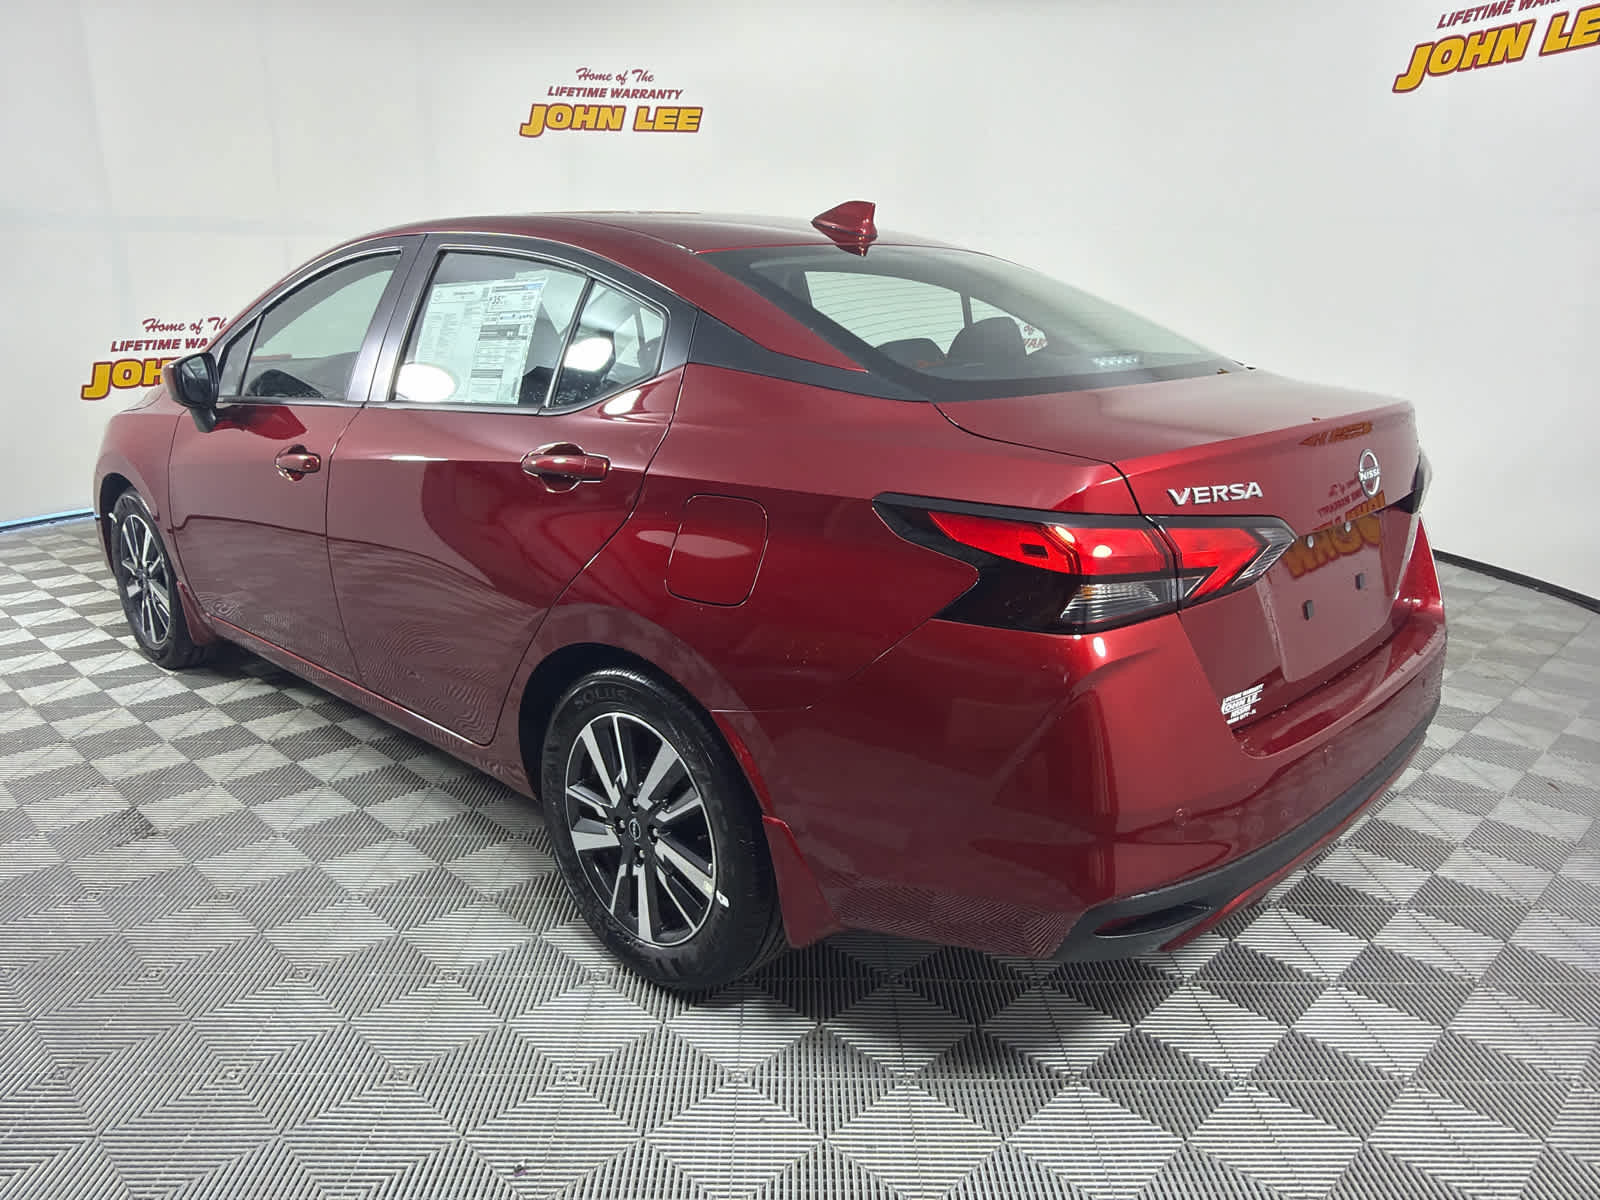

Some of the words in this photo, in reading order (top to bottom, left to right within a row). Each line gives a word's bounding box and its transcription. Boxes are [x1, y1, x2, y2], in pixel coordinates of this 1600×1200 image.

[1436, 0, 1515, 29] LIFETIME
[1392, 18, 1537, 93] JOHN
[1538, 3, 1600, 57] LE
[576, 67, 613, 81] Home
[615, 70, 629, 86] of
[631, 69, 655, 82] The
[547, 86, 608, 98] LIFETIME
[610, 87, 684, 100] WARRANTY
[519, 103, 626, 138] JOHN
[633, 105, 703, 133] LEE
[142, 318, 186, 332] Home
[190, 319, 203, 335] of
[110, 339, 182, 352] LIFETIME
[81, 357, 181, 400] JOH
[1167, 482, 1264, 506] VERSA
